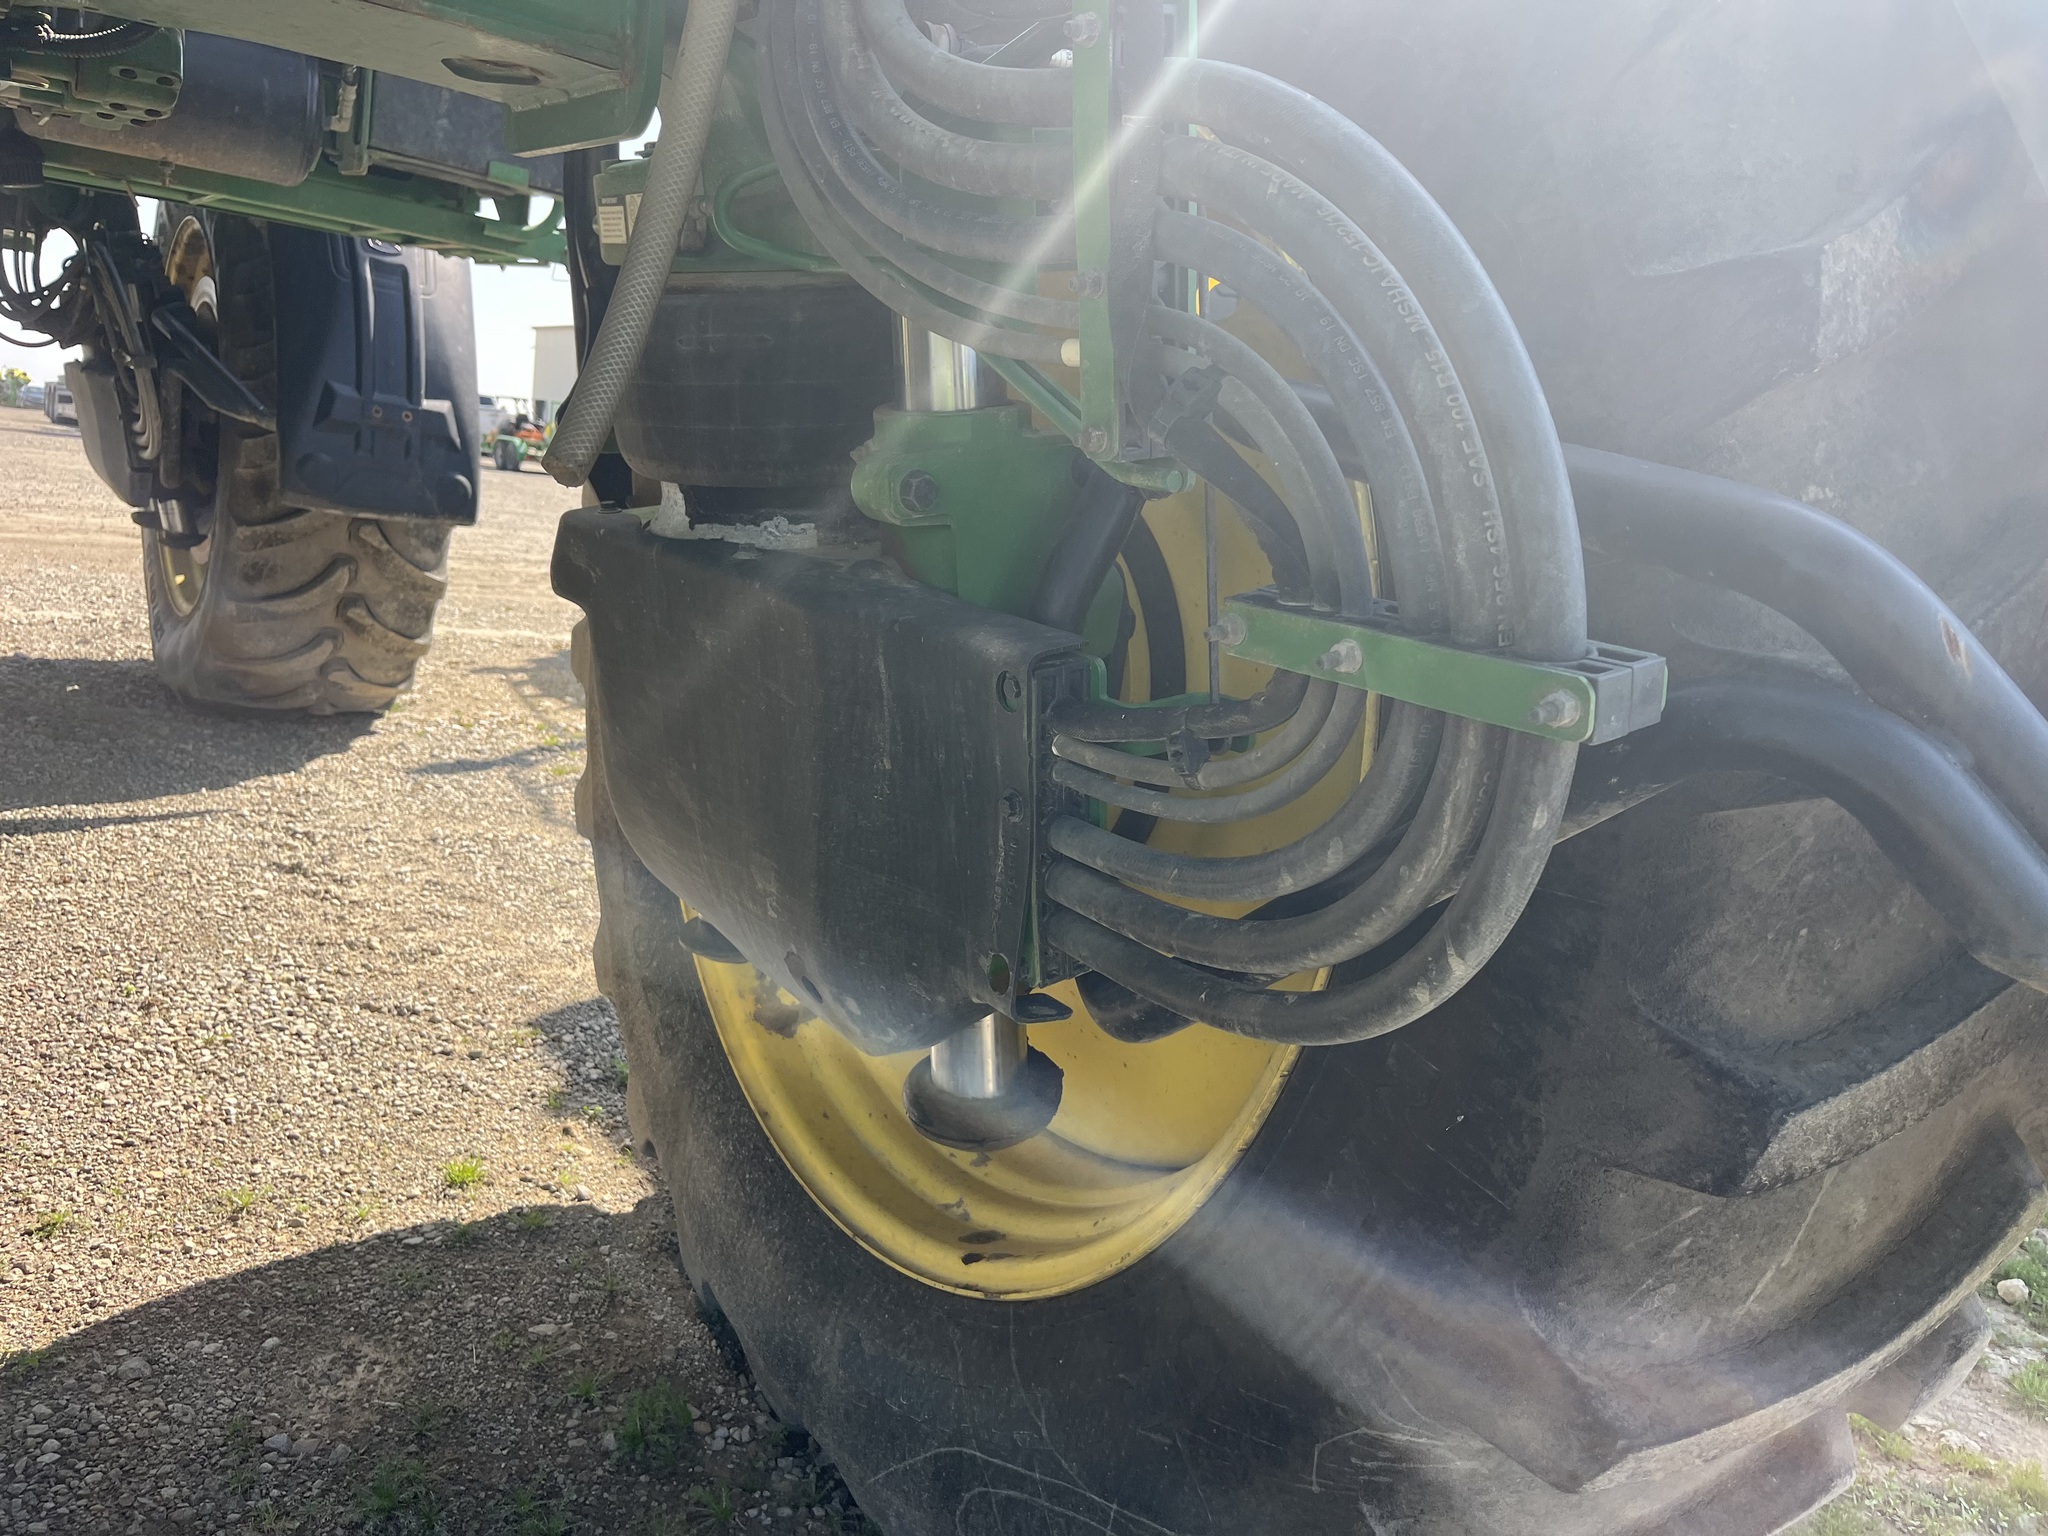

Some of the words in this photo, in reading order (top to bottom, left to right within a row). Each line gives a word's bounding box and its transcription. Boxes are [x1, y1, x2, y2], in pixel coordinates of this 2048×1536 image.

[809, 43, 818, 55] 19
[821, 99, 835, 115] 857
[829, 117, 841, 129] EN
[1316, 203, 1382, 273] IC-152/16
[1381, 274, 1430, 334] MSHA
[1320, 316, 1336, 331] 19
[1334, 336, 1352, 353] DN
[1348, 357, 1368, 380] 1SC
[1424, 350, 1457, 389] R15
[1364, 388, 1386, 413] 857
[1446, 392, 1472, 432] 100
[1381, 419, 1398, 439] EN
[1461, 437, 1491, 487] SAE
